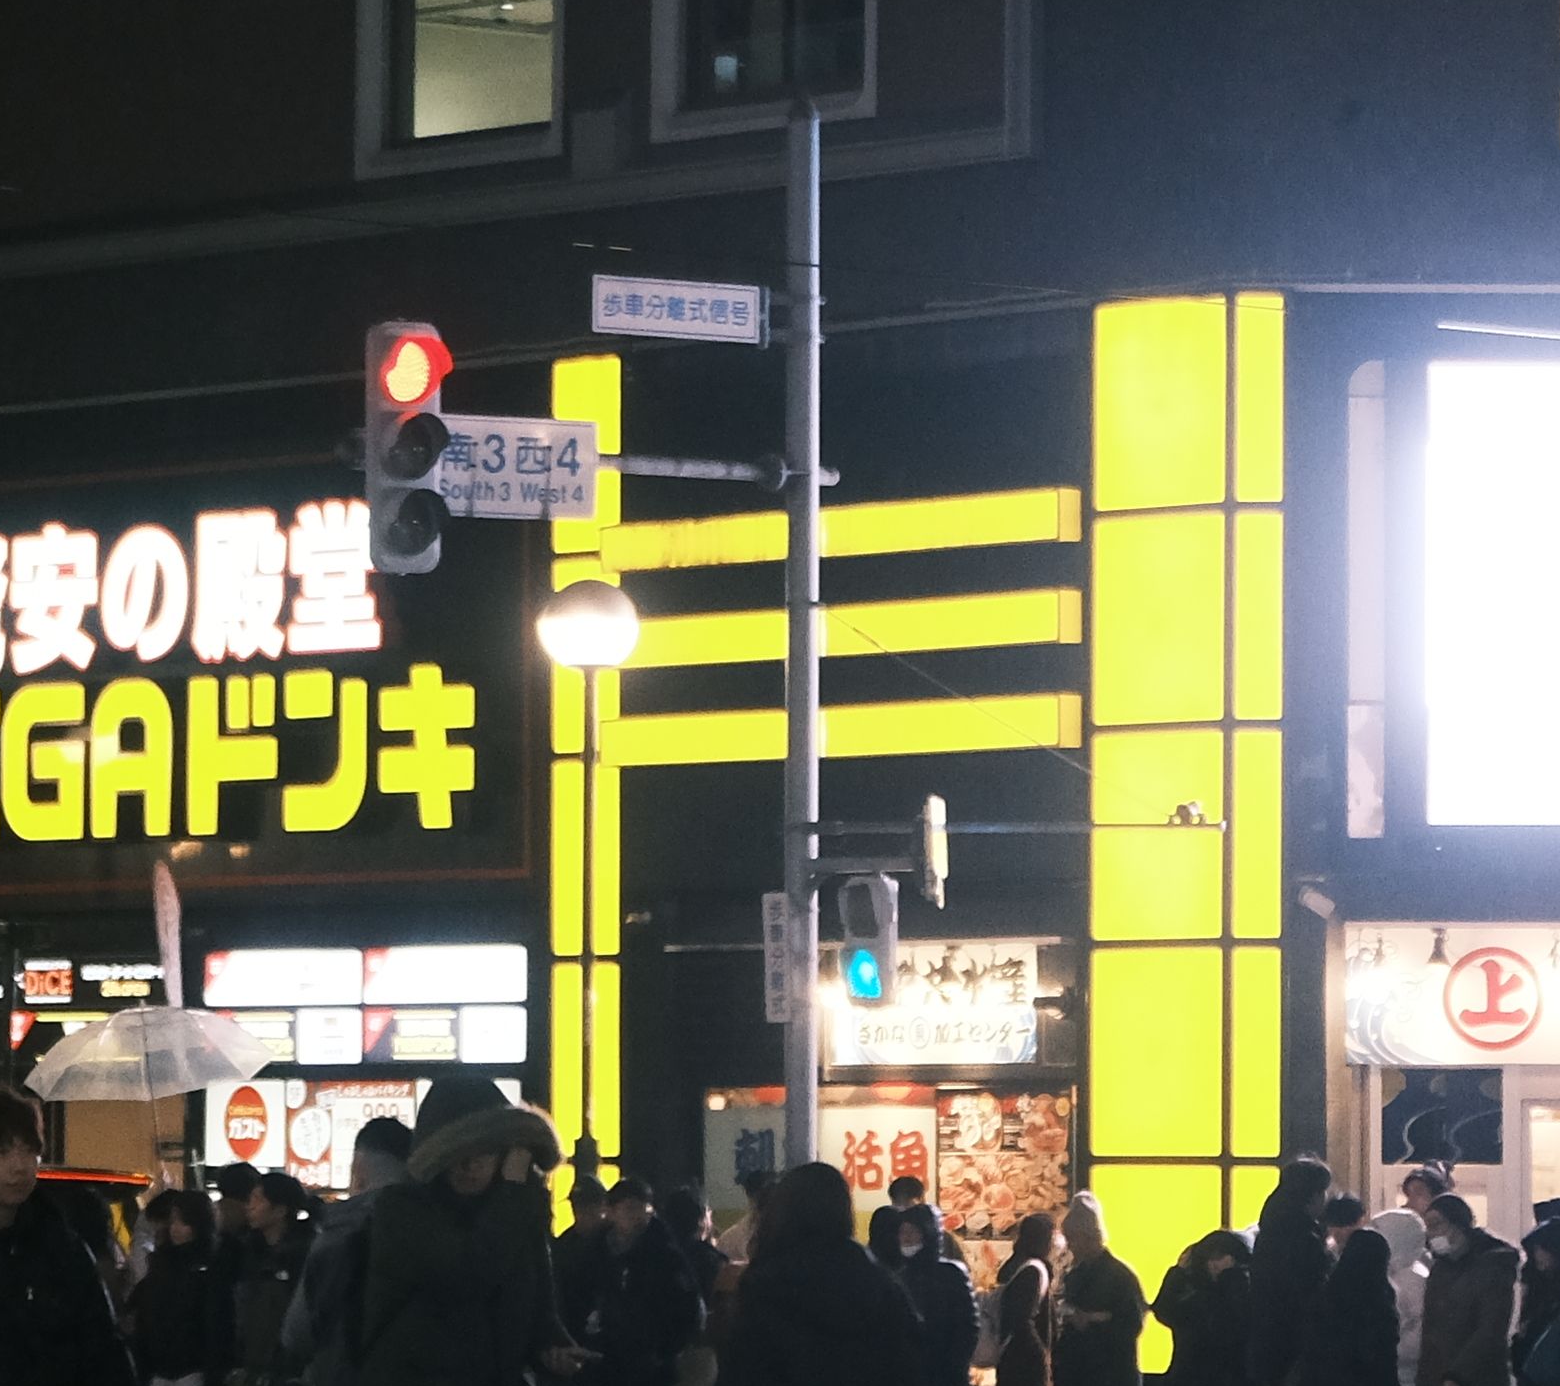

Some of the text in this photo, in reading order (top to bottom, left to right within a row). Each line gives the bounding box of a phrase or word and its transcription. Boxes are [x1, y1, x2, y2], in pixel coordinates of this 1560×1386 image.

[601, 293, 750, 327] 歩車分離式信号
[440, 433, 581, 478] 南3西4
[499, 484, 511, 502] 3
[573, 487, 585, 503] 4
[227, 1116, 266, 1144] ガスト
